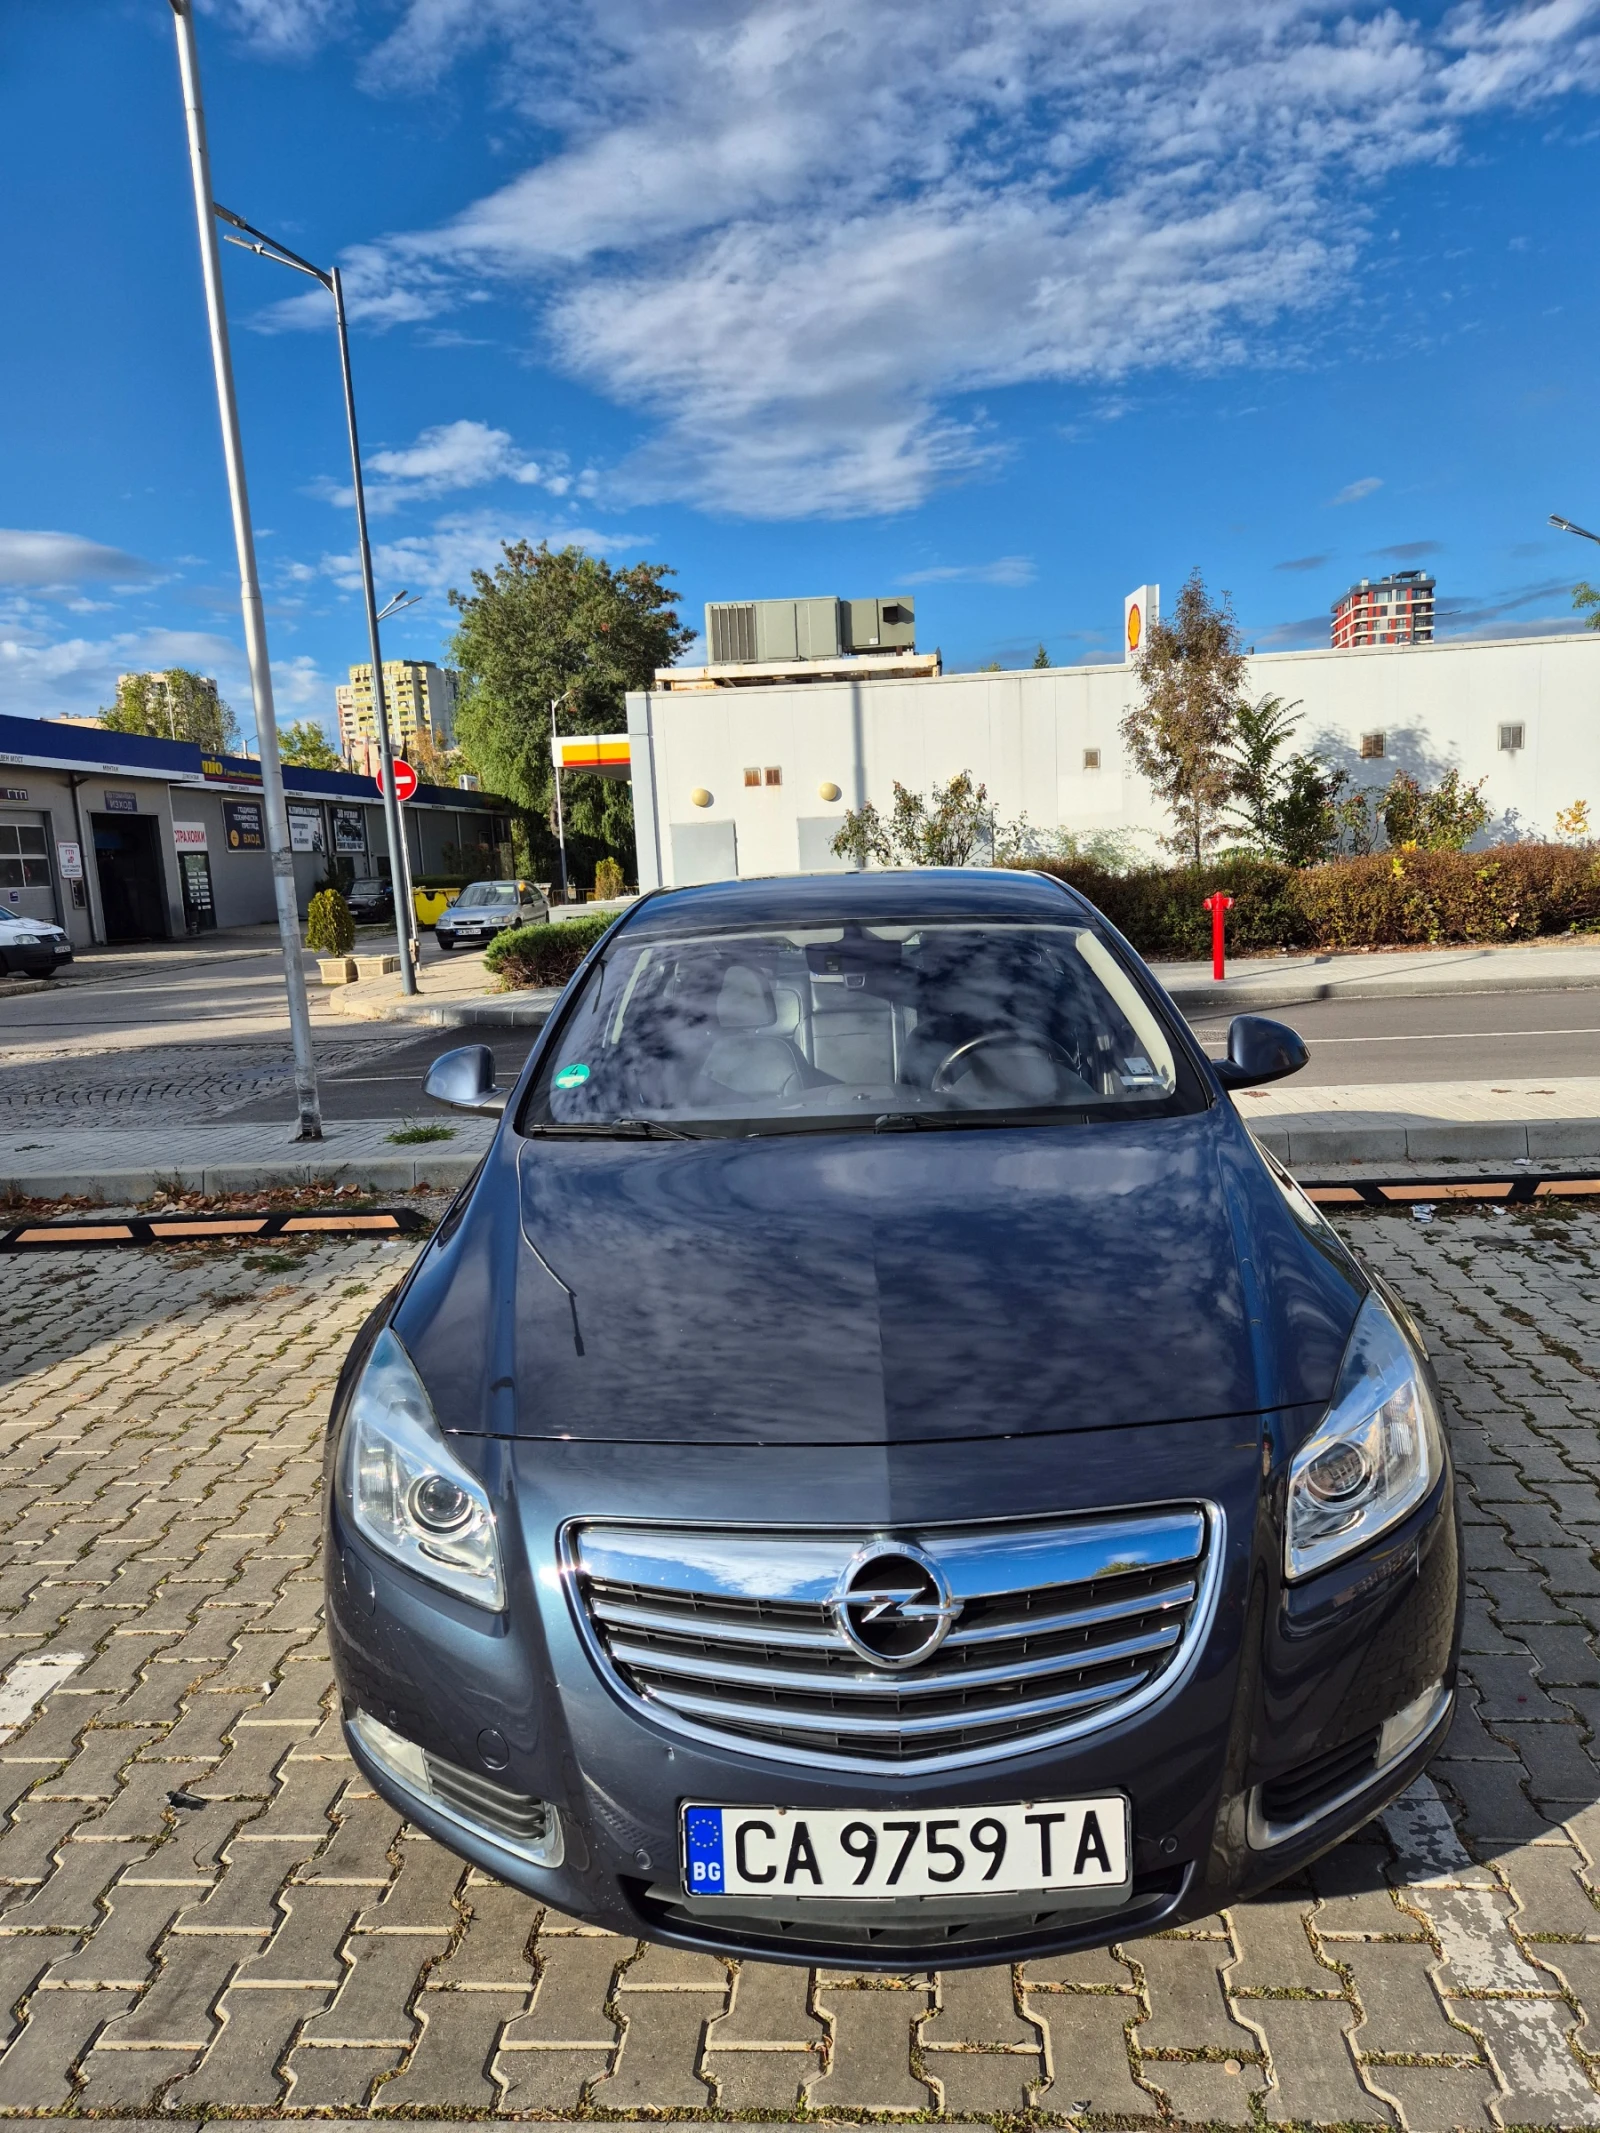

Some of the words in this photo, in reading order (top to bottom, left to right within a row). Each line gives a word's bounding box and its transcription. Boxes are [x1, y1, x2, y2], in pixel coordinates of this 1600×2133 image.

[7, 789, 28, 799] ГТП
[109, 800, 133, 811] ИЗХОД
[237, 806, 257, 814] ГОДИШЕН
[233, 814, 259, 822] ТЕХНИЧЕСКИ
[241, 822, 260, 830] ПРЕГЛЕД
[242, 833, 261, 845] ВХОД
[569, 1064, 579, 1076] 4
[735, 1820, 823, 1885] CA
[840, 1817, 1007, 1886] 9759
[1024, 1809, 1112, 1877] TA
[693, 1861, 721, 1882] BG
